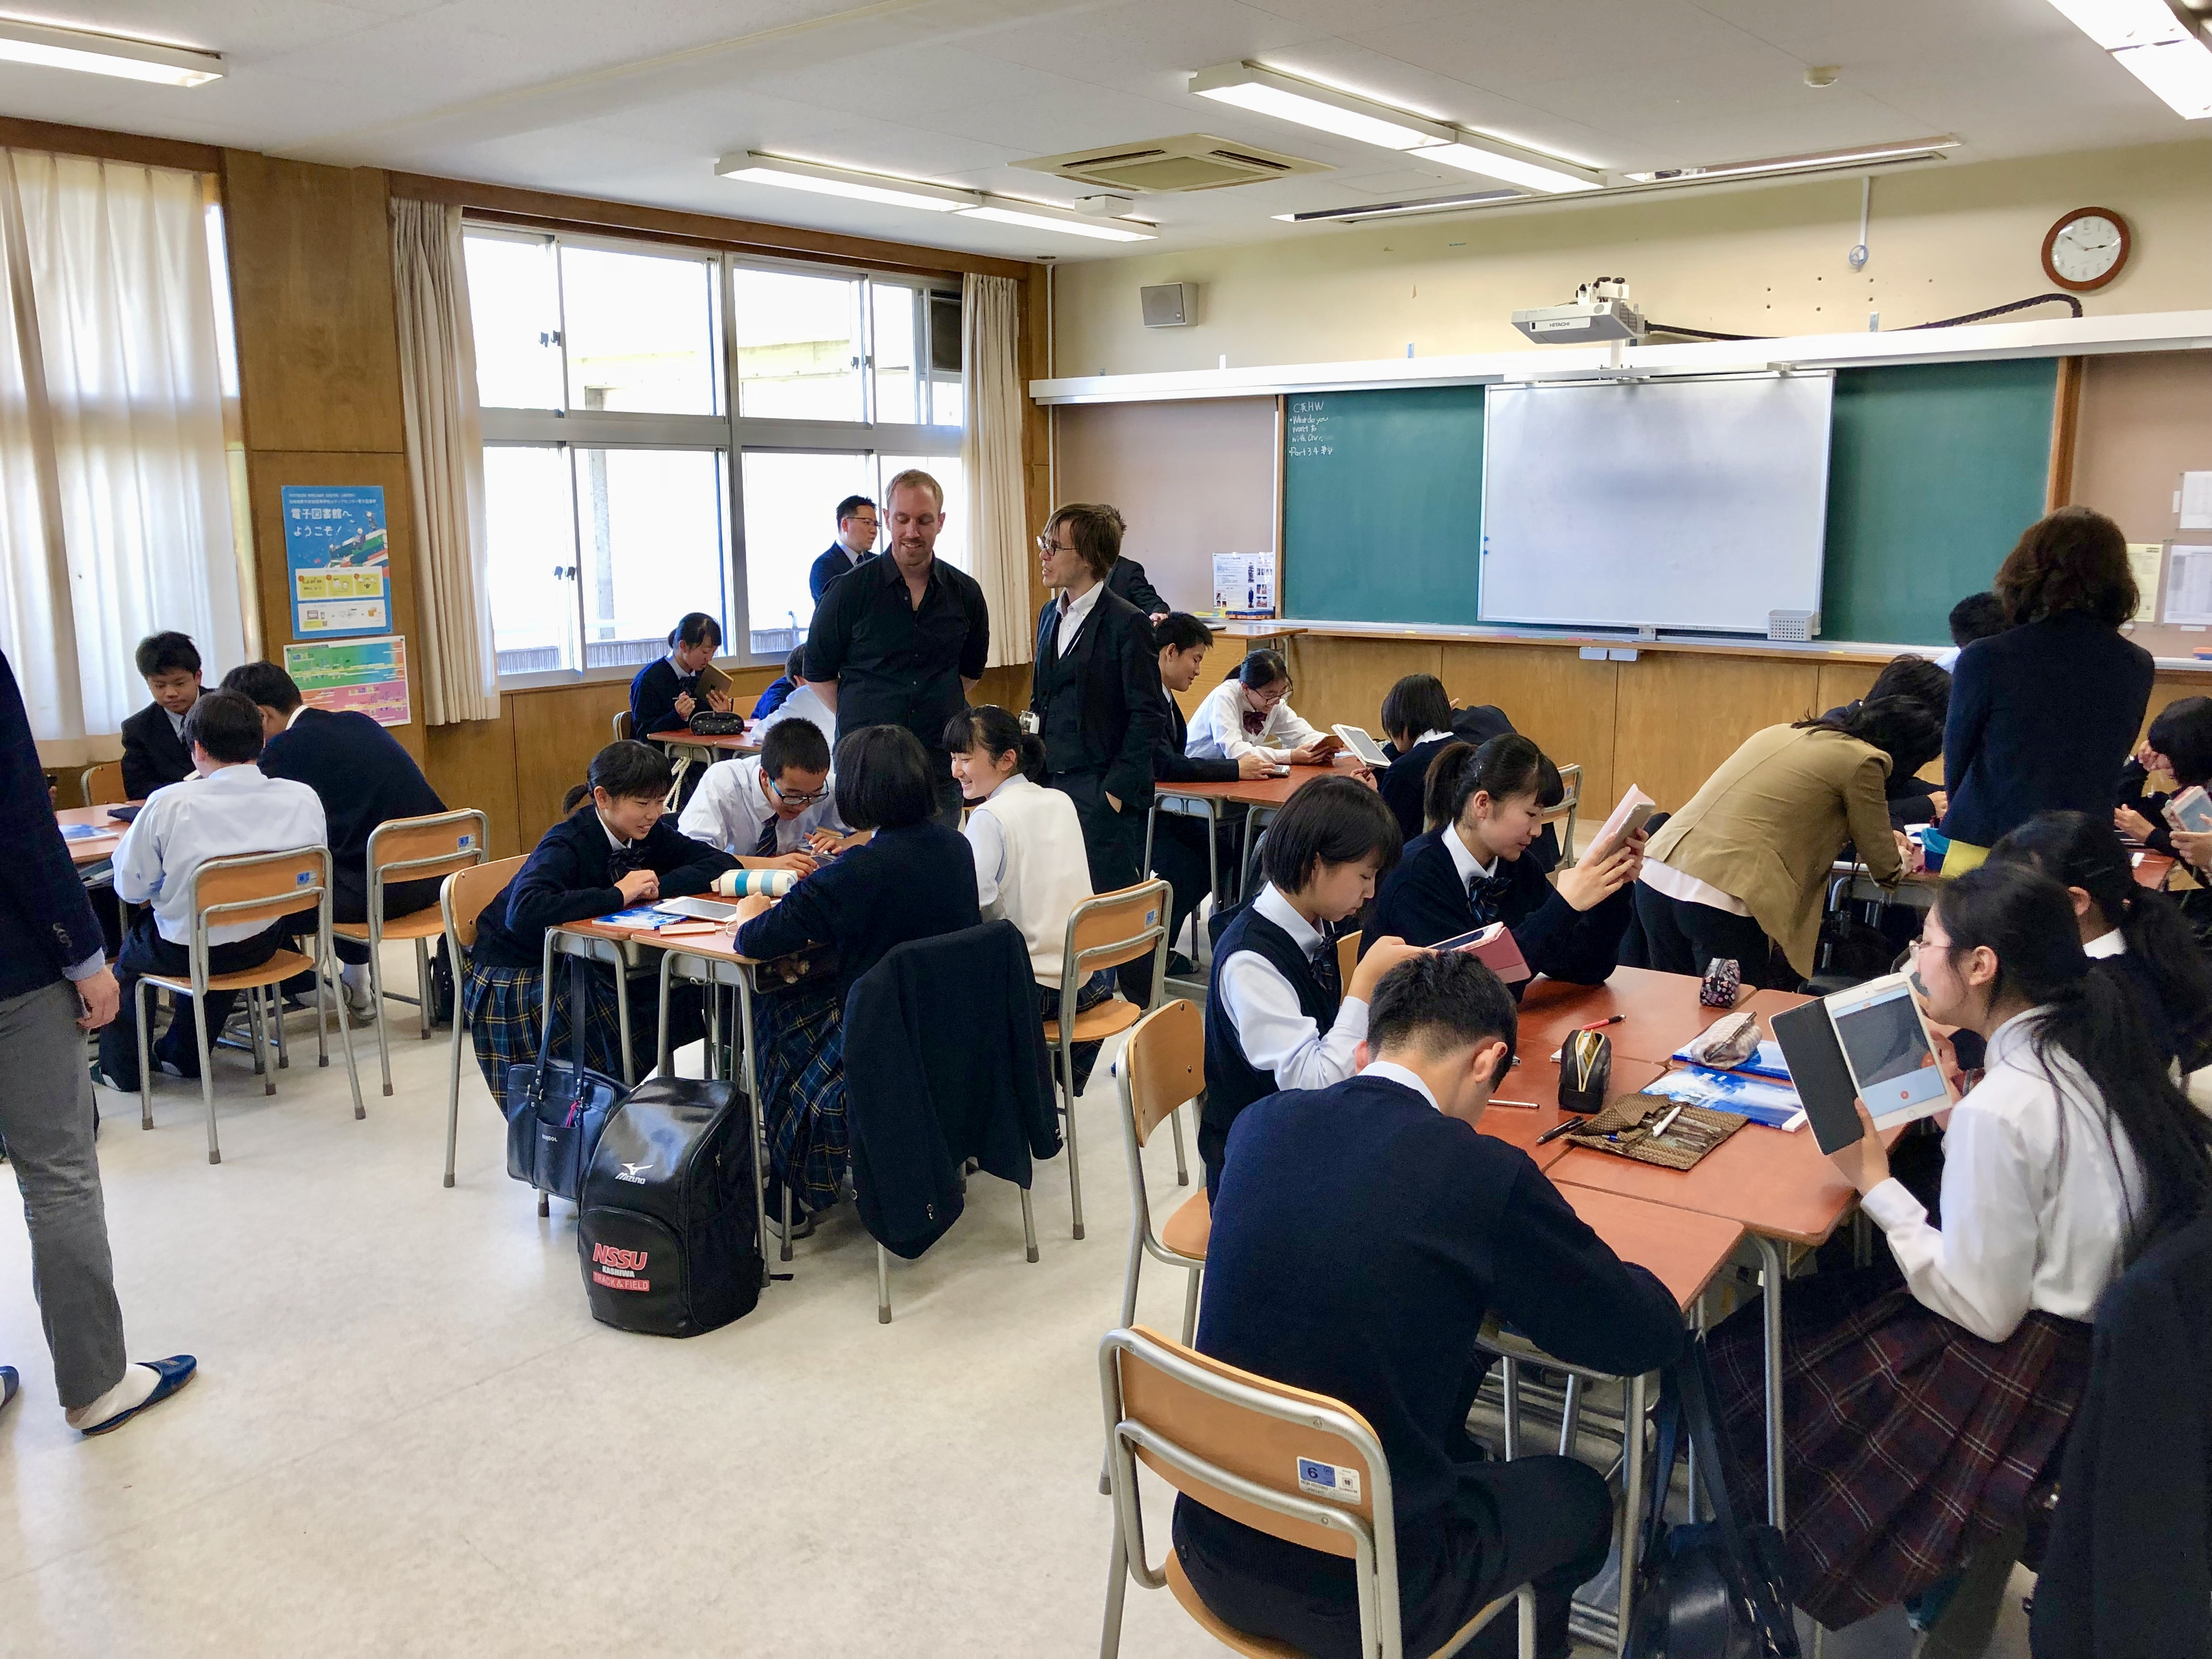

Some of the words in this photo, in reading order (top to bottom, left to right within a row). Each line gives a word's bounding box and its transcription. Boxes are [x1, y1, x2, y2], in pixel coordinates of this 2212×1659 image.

[1308, 414, 1315, 423] do
[1292, 434, 1307, 442] with
[1290, 447, 1306, 456] Part
[592, 1242, 648, 1271] NSSU
[601, 1265, 635, 1278] KASHIWA
[593, 1272, 616, 1287] TRACK
[625, 1280, 648, 1290] FIELD
[1307, 1467, 1318, 1479] 6
